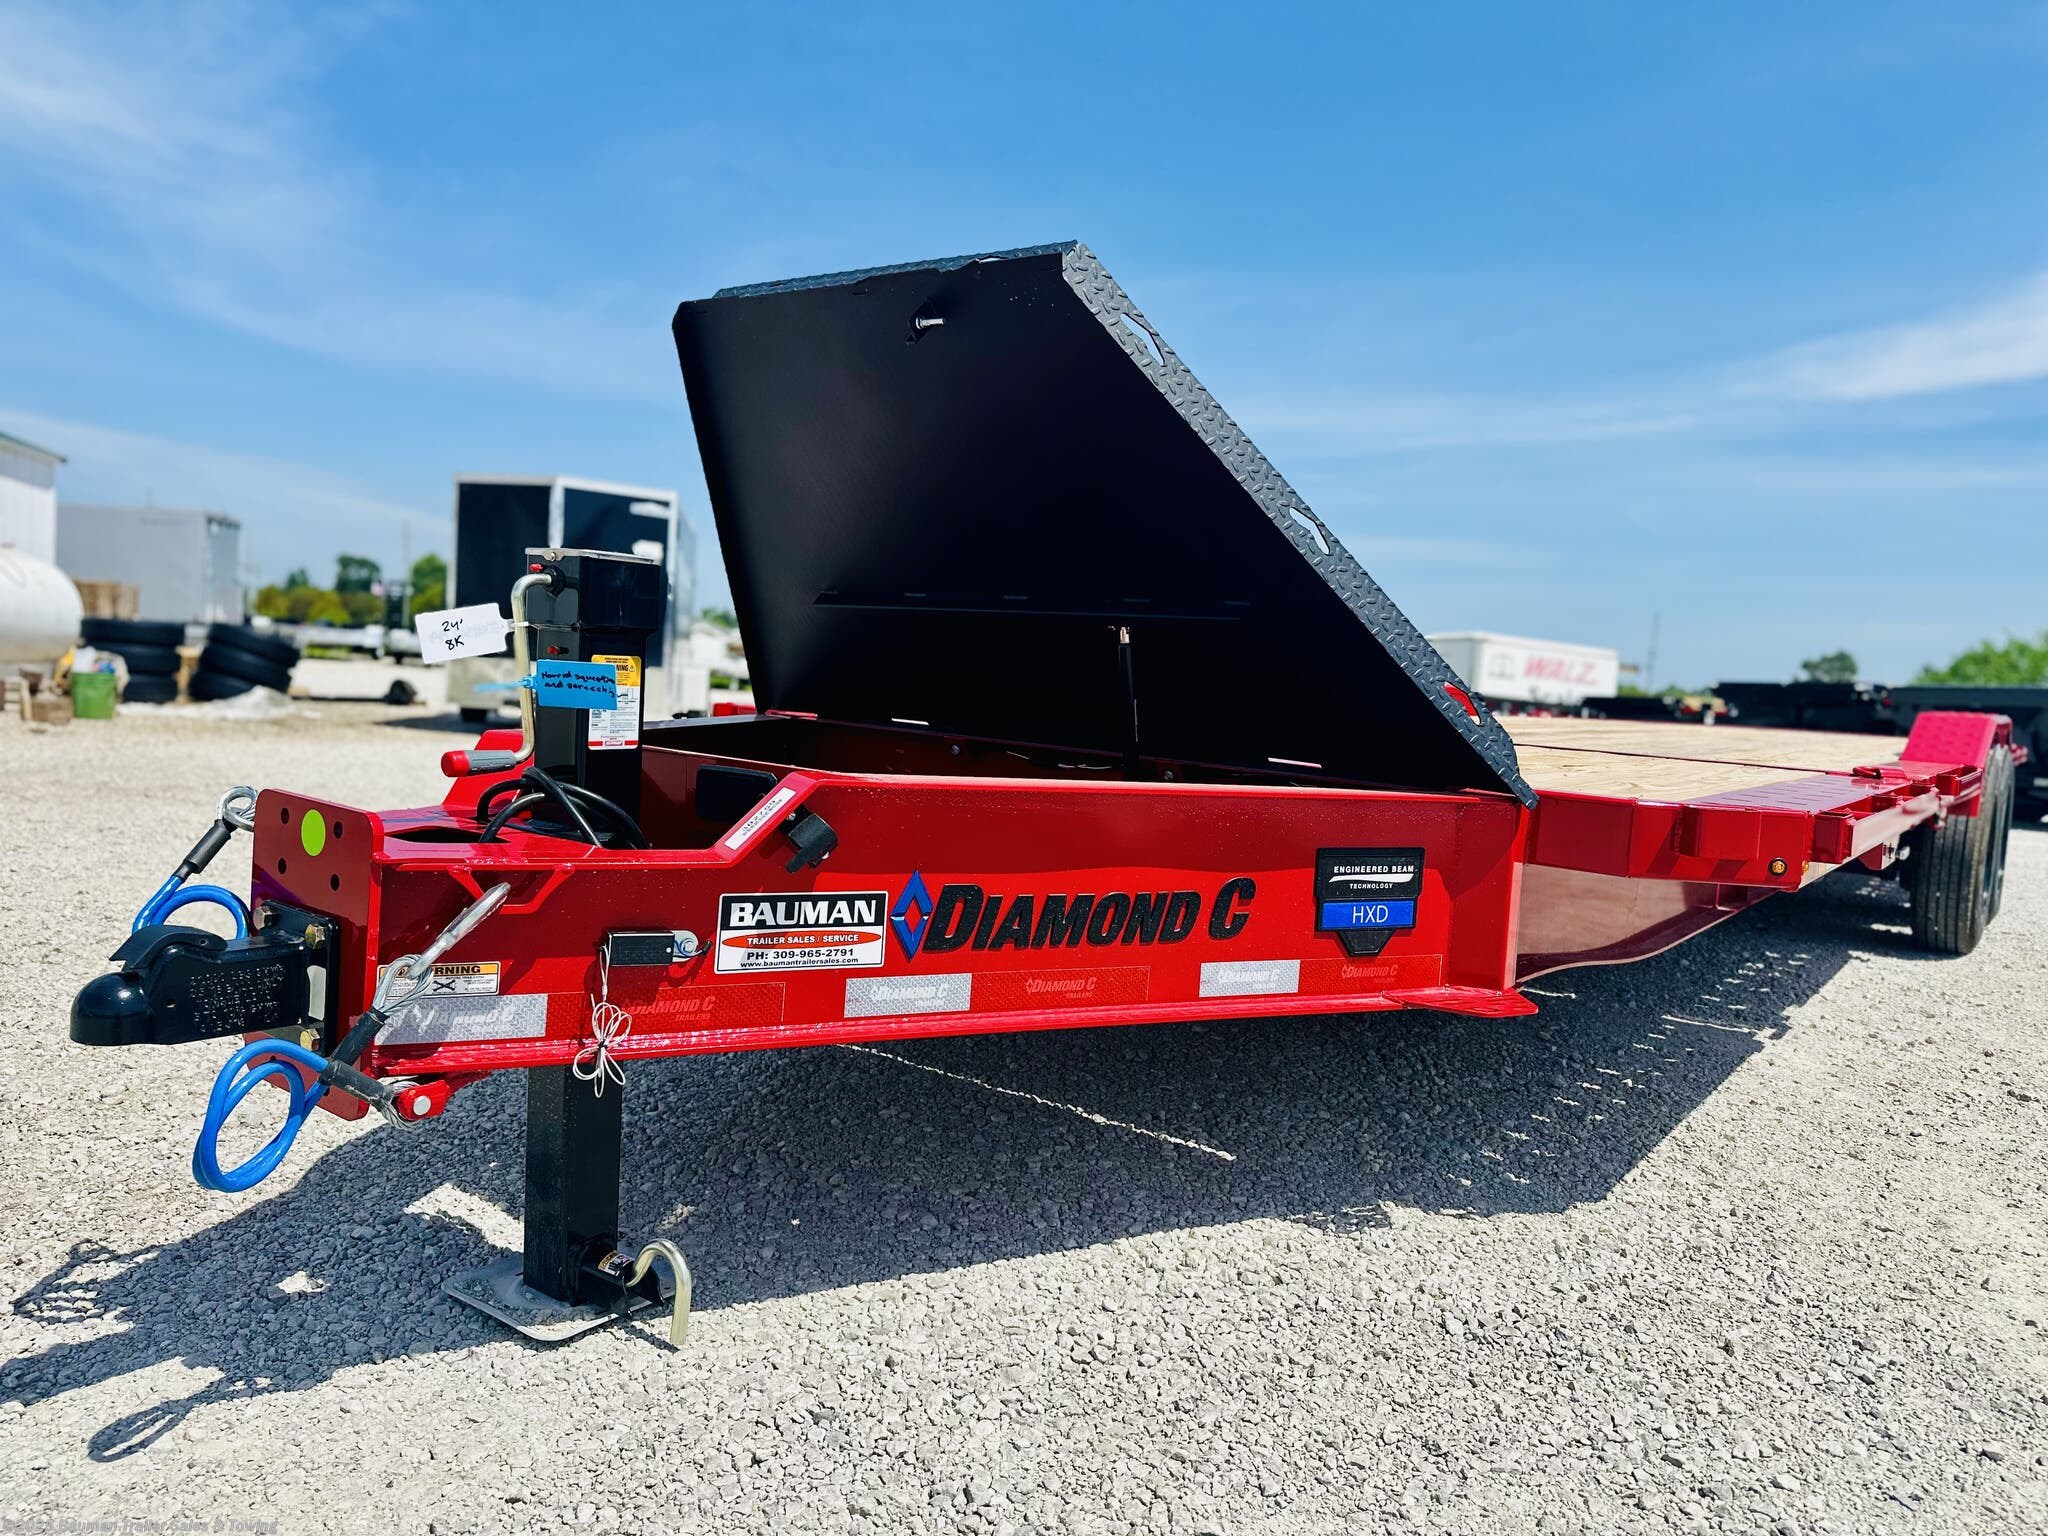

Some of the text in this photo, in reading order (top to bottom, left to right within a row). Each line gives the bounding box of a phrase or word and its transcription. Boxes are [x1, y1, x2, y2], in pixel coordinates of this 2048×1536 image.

[445, 635, 464, 651] 8K
[544, 680, 564, 688] and
[1334, 865, 1414, 873] ENGINEERED BEAM
[729, 900, 876, 927] BAUMAN
[922, 876, 1257, 953] DIAMOND C
[1352, 905, 1389, 924] HXD
[747, 936, 785, 945] TRAILER
[786, 935, 815, 944] SALES
[822, 934, 859, 943] SERVICE
[747, 949, 854, 960] PH: 309-965-2791
[740, 957, 859, 968] www.baumantrailersales.com
[435, 965, 481, 975] RNING
[1390, 964, 1399, 976] C
[1031, 976, 1097, 993] DIAMOND C
[702, 996, 716, 1011] C
